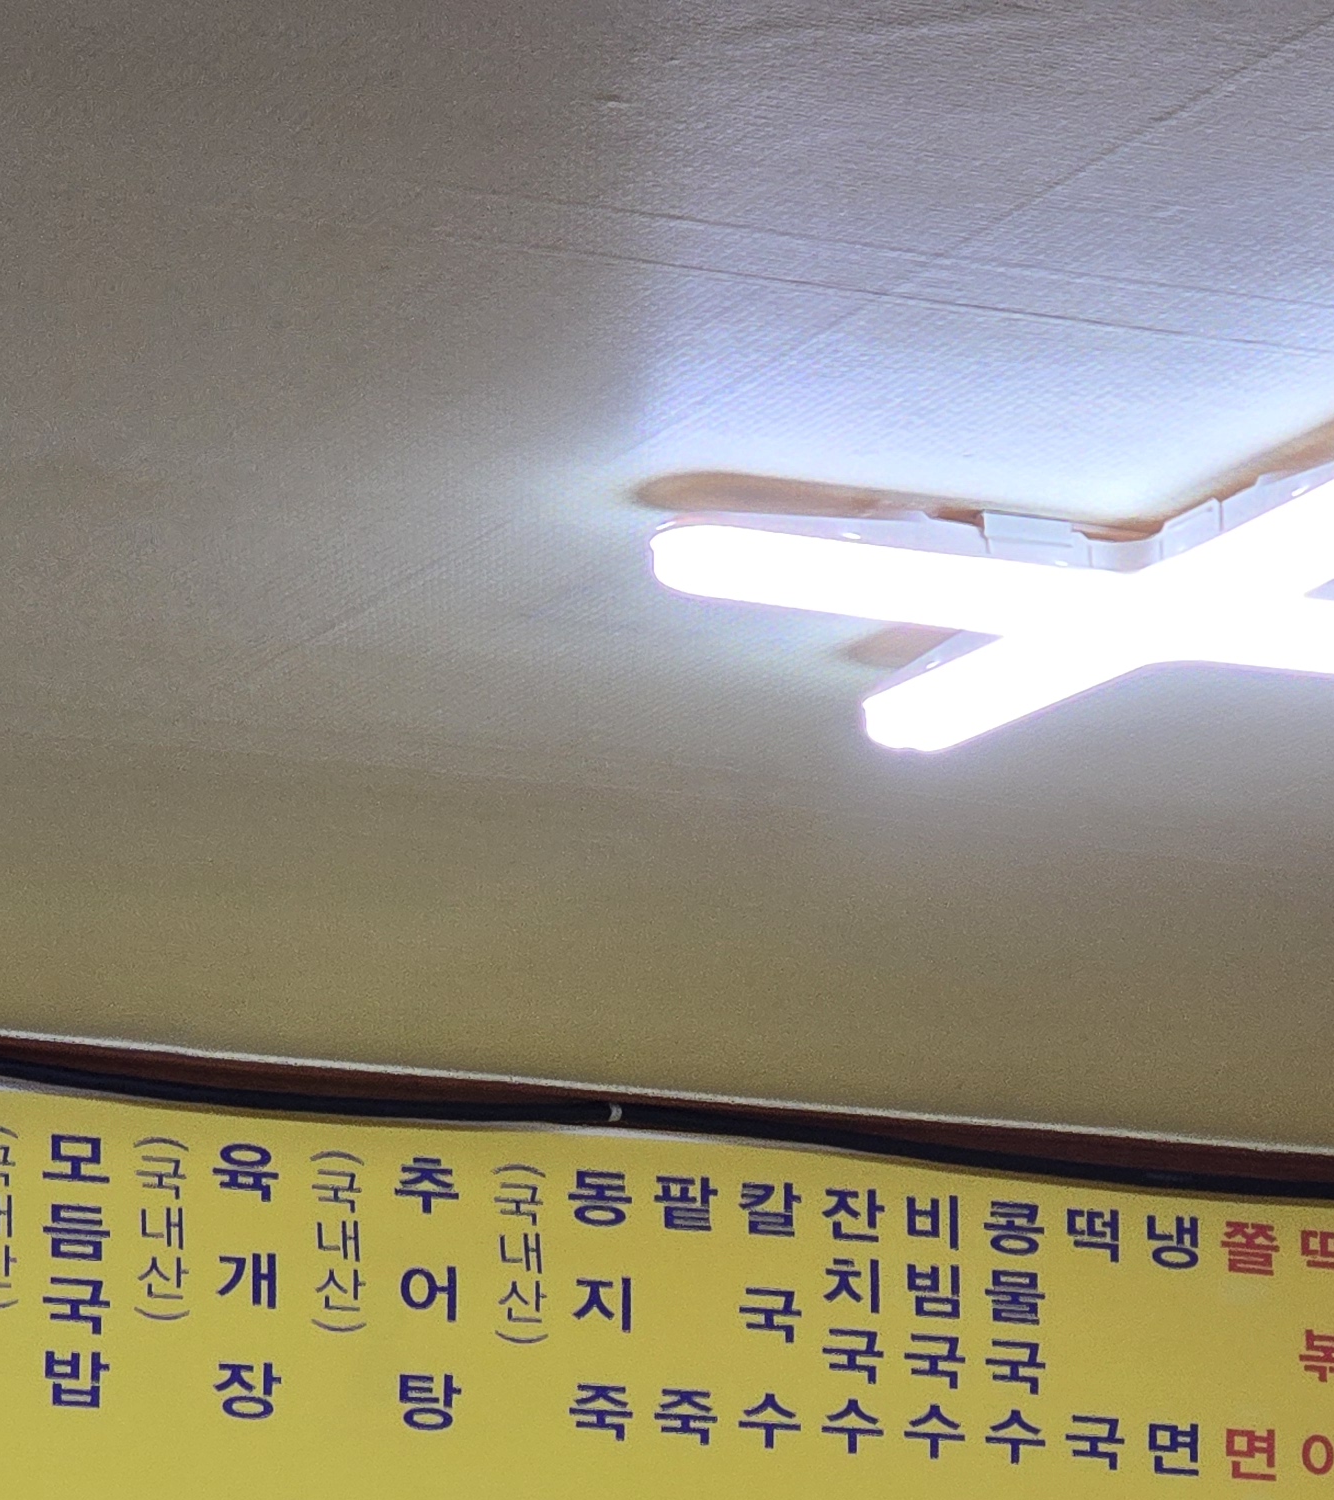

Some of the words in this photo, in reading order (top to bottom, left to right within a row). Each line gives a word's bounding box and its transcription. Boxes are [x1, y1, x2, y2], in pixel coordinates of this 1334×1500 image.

[42, 1134, 110, 1408] 모듬국밥
[134, 1137, 188, 1320] (국내산)
[212, 1143, 281, 1419] 육개장
[311, 1151, 365, 1332] (국내산)
[394, 1157, 462, 1430] 추어탕
[494, 1164, 547, 1343] (국내산)
[568, 1169, 633, 1441] 동지죽
[654, 1176, 718, 1445] 팥죽
[738, 1182, 802, 1449] 칼국수
[822, 1188, 885, 1454] 잔치국수
[904, 1195, 965, 1459] 비빔국수
[984, 1201, 1046, 1464] 콩물국수
[1065, 1208, 1125, 1470] 떡국
[1147, 1215, 1199, 1476] 냉면
[1221, 1221, 1280, 1481] 쫄면
